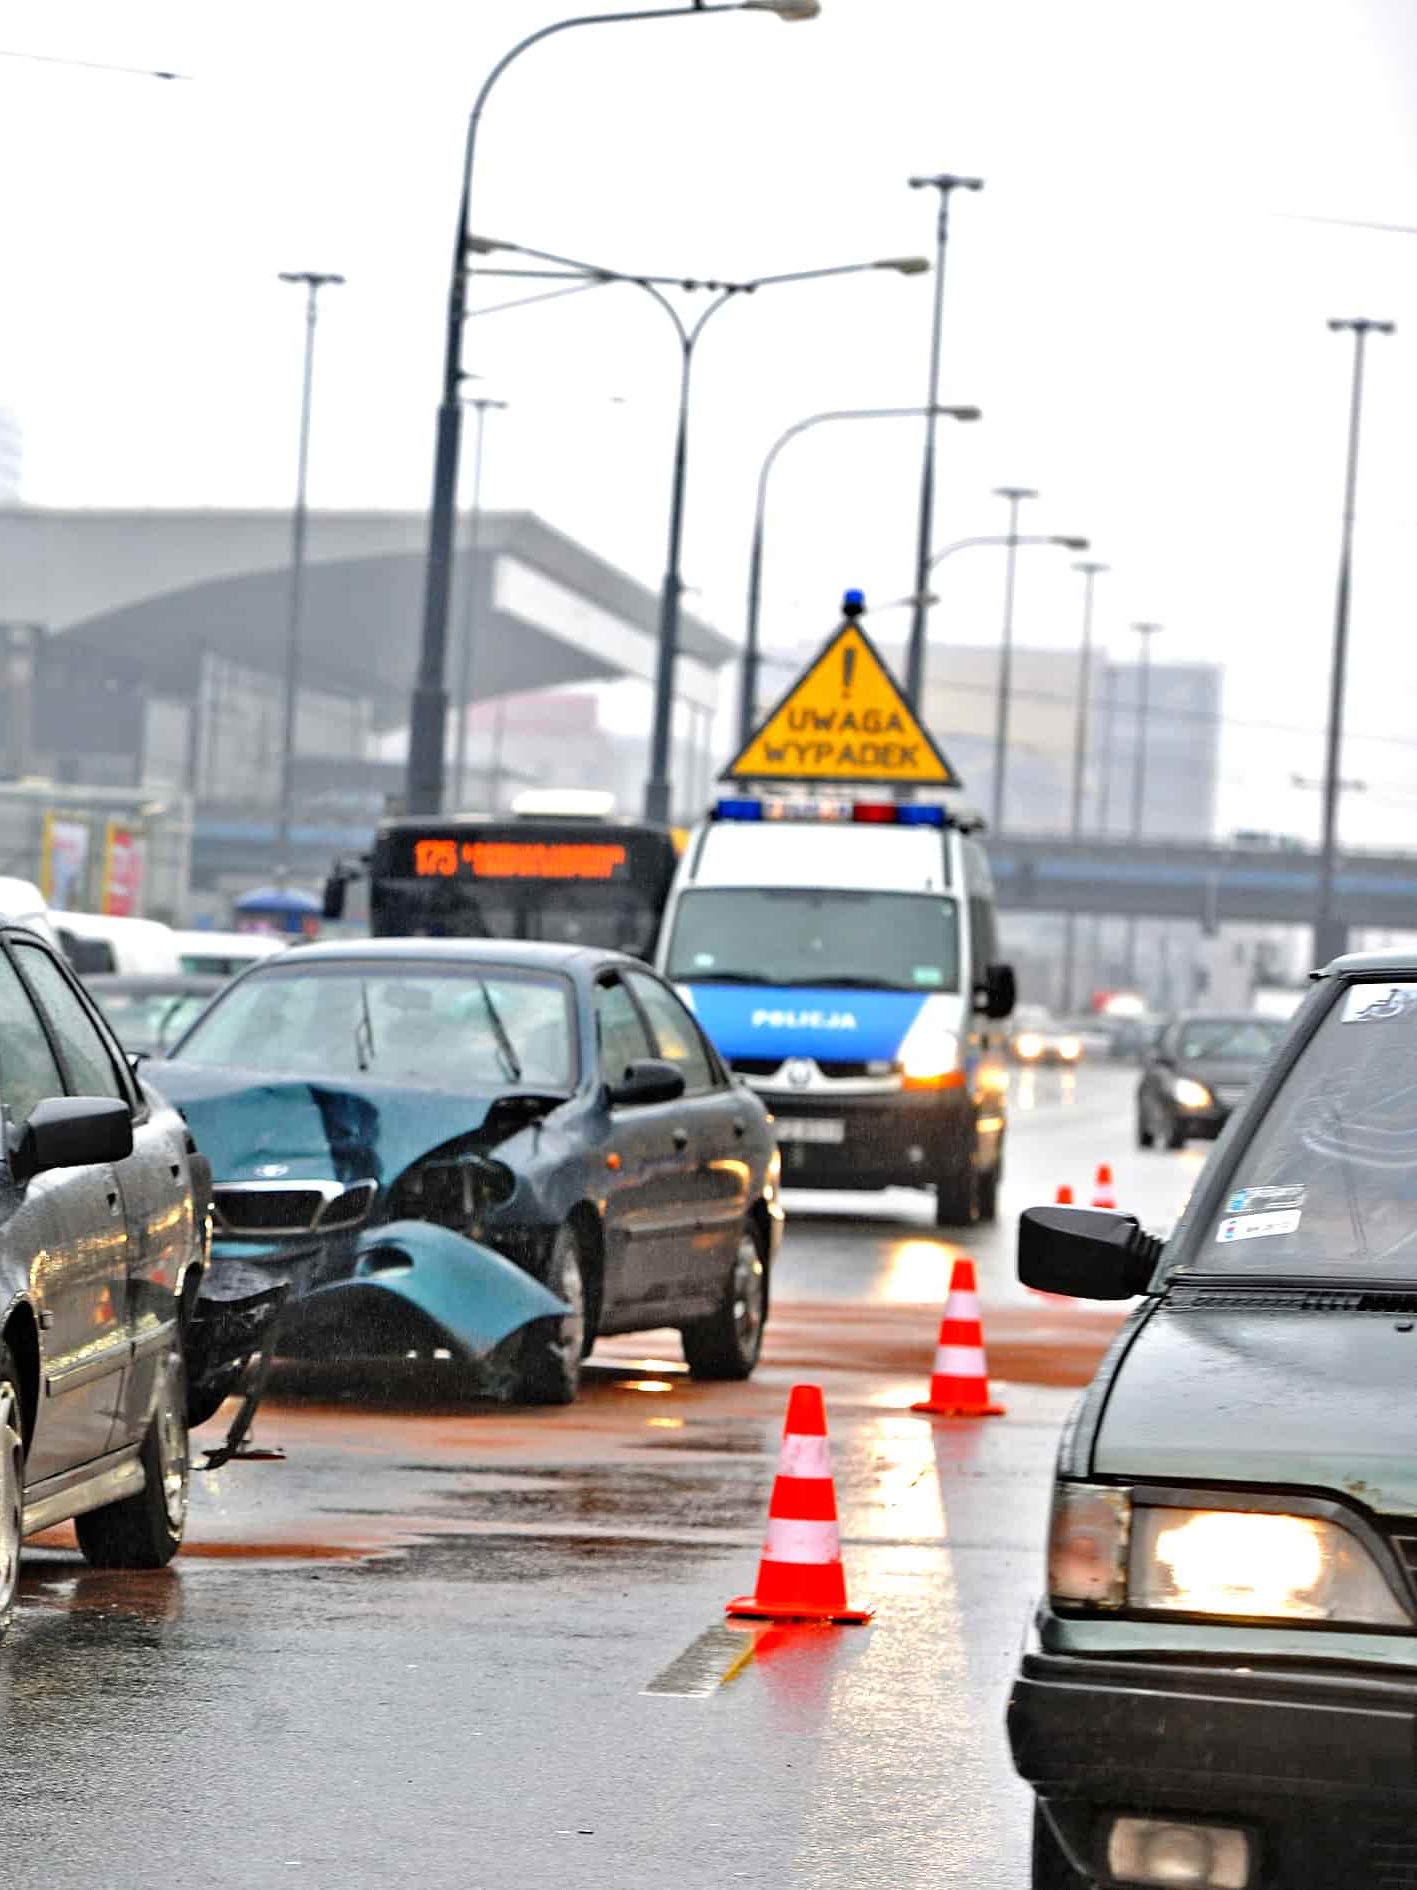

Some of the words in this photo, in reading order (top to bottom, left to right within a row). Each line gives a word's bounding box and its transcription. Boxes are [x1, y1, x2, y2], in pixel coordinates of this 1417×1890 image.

[788, 708, 905, 733] UWAGA
[763, 740, 920, 768] WYPADEK
[751, 1007, 859, 1032] POLICJA
